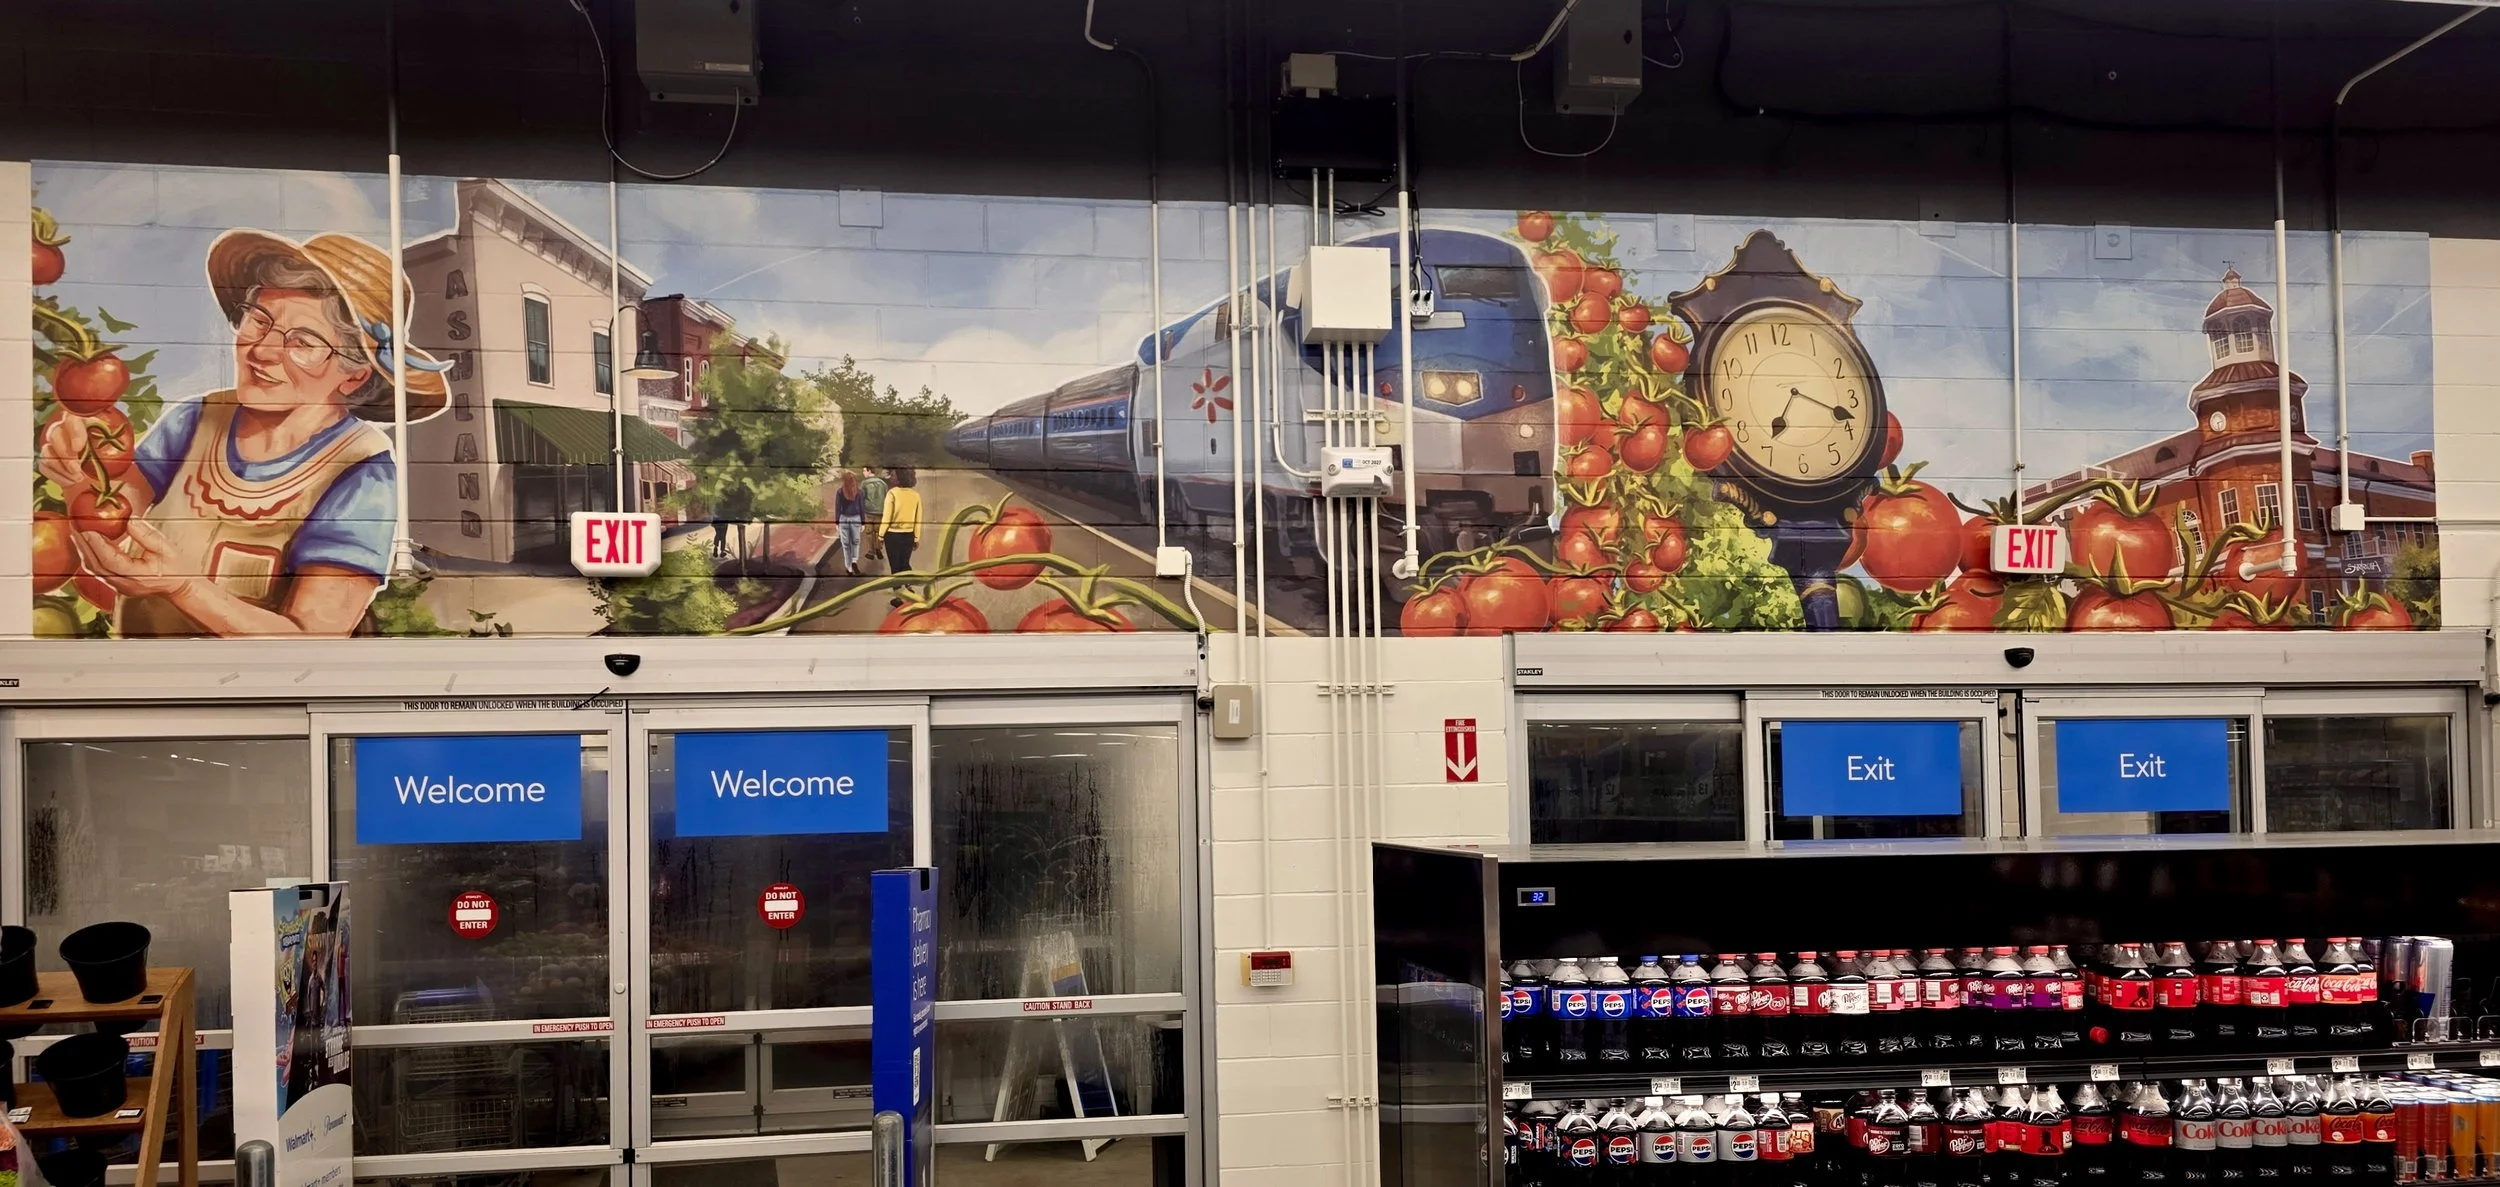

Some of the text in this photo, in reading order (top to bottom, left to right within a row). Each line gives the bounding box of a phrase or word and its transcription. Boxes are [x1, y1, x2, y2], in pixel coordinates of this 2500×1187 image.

[1744, 332, 1758, 355] 11
[1770, 323, 1791, 347] 12
[1810, 333, 1816, 356] 1
[1723, 357, 1743, 381] 10
[1833, 358, 1845, 379] 2
[445, 268, 483, 538] ASHLAND
[1721, 388, 1733, 412] 9
[1847, 389, 1859, 408] 3
[1736, 420, 1750, 443] 8
[1844, 421, 1854, 440] 4
[1761, 445, 1774, 467] 7
[1798, 453, 1809, 475] 6
[1827, 442, 1841, 466] 5
[586, 520, 647, 564] EXIT
[2008, 527, 2057, 569] EXIT
[404, 702, 419, 710] THIS
[420, 702, 440, 710] DOOR
[450, 701, 477, 709] REMAIN
[479, 701, 514, 709] UNLOCKED
[538, 700, 550, 708] THE
[1847, 756, 1895, 782] Exit
[2120, 753, 2166, 780] Exit
[393, 775, 546, 805] Welcome
[711, 769, 855, 799] Welcome
[457, 900, 490, 909] DO NOT
[765, 891, 797, 900] DO NOT
[1533, 892, 1544, 901] 32
[460, 921, 488, 929] ENTER
[768, 912, 795, 920] ENTER
[1024, 1000, 1091, 1010] CAUTION STAND BACK
[541, 1024, 574, 1032] EMERGENCY
[575, 1023, 590, 1031] PUSH
[599, 1022, 613, 1030] OPEN
[654, 1019, 686, 1027] EMERGENCY
[687, 1018, 701, 1026] PUSH
[2182, 1122, 2215, 1139] Cok
[2218, 1121, 2252, 1137] Cok
